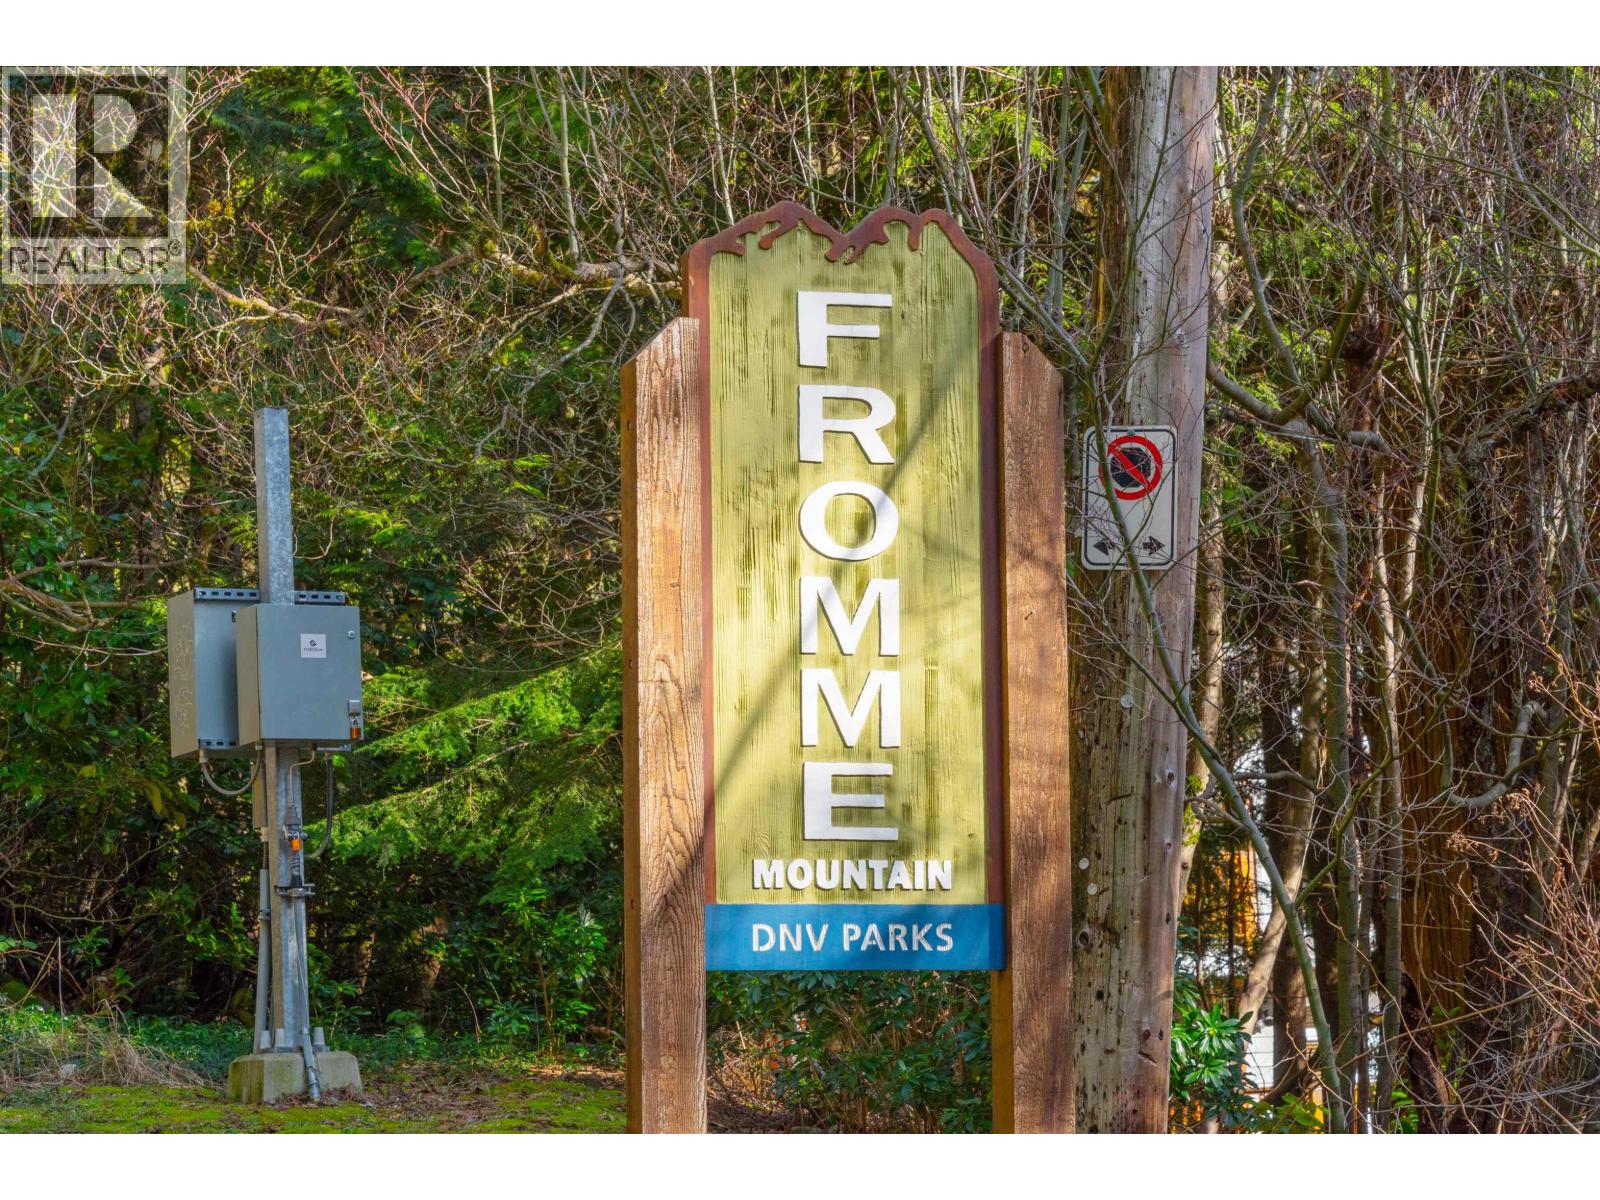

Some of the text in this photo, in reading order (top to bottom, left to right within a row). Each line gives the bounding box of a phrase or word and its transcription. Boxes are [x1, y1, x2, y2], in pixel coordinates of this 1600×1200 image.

[797, 290, 902, 842] FROMME
[752, 858, 952, 890] MOUNTAIN
[751, 923, 954, 952] DNV PARKS
